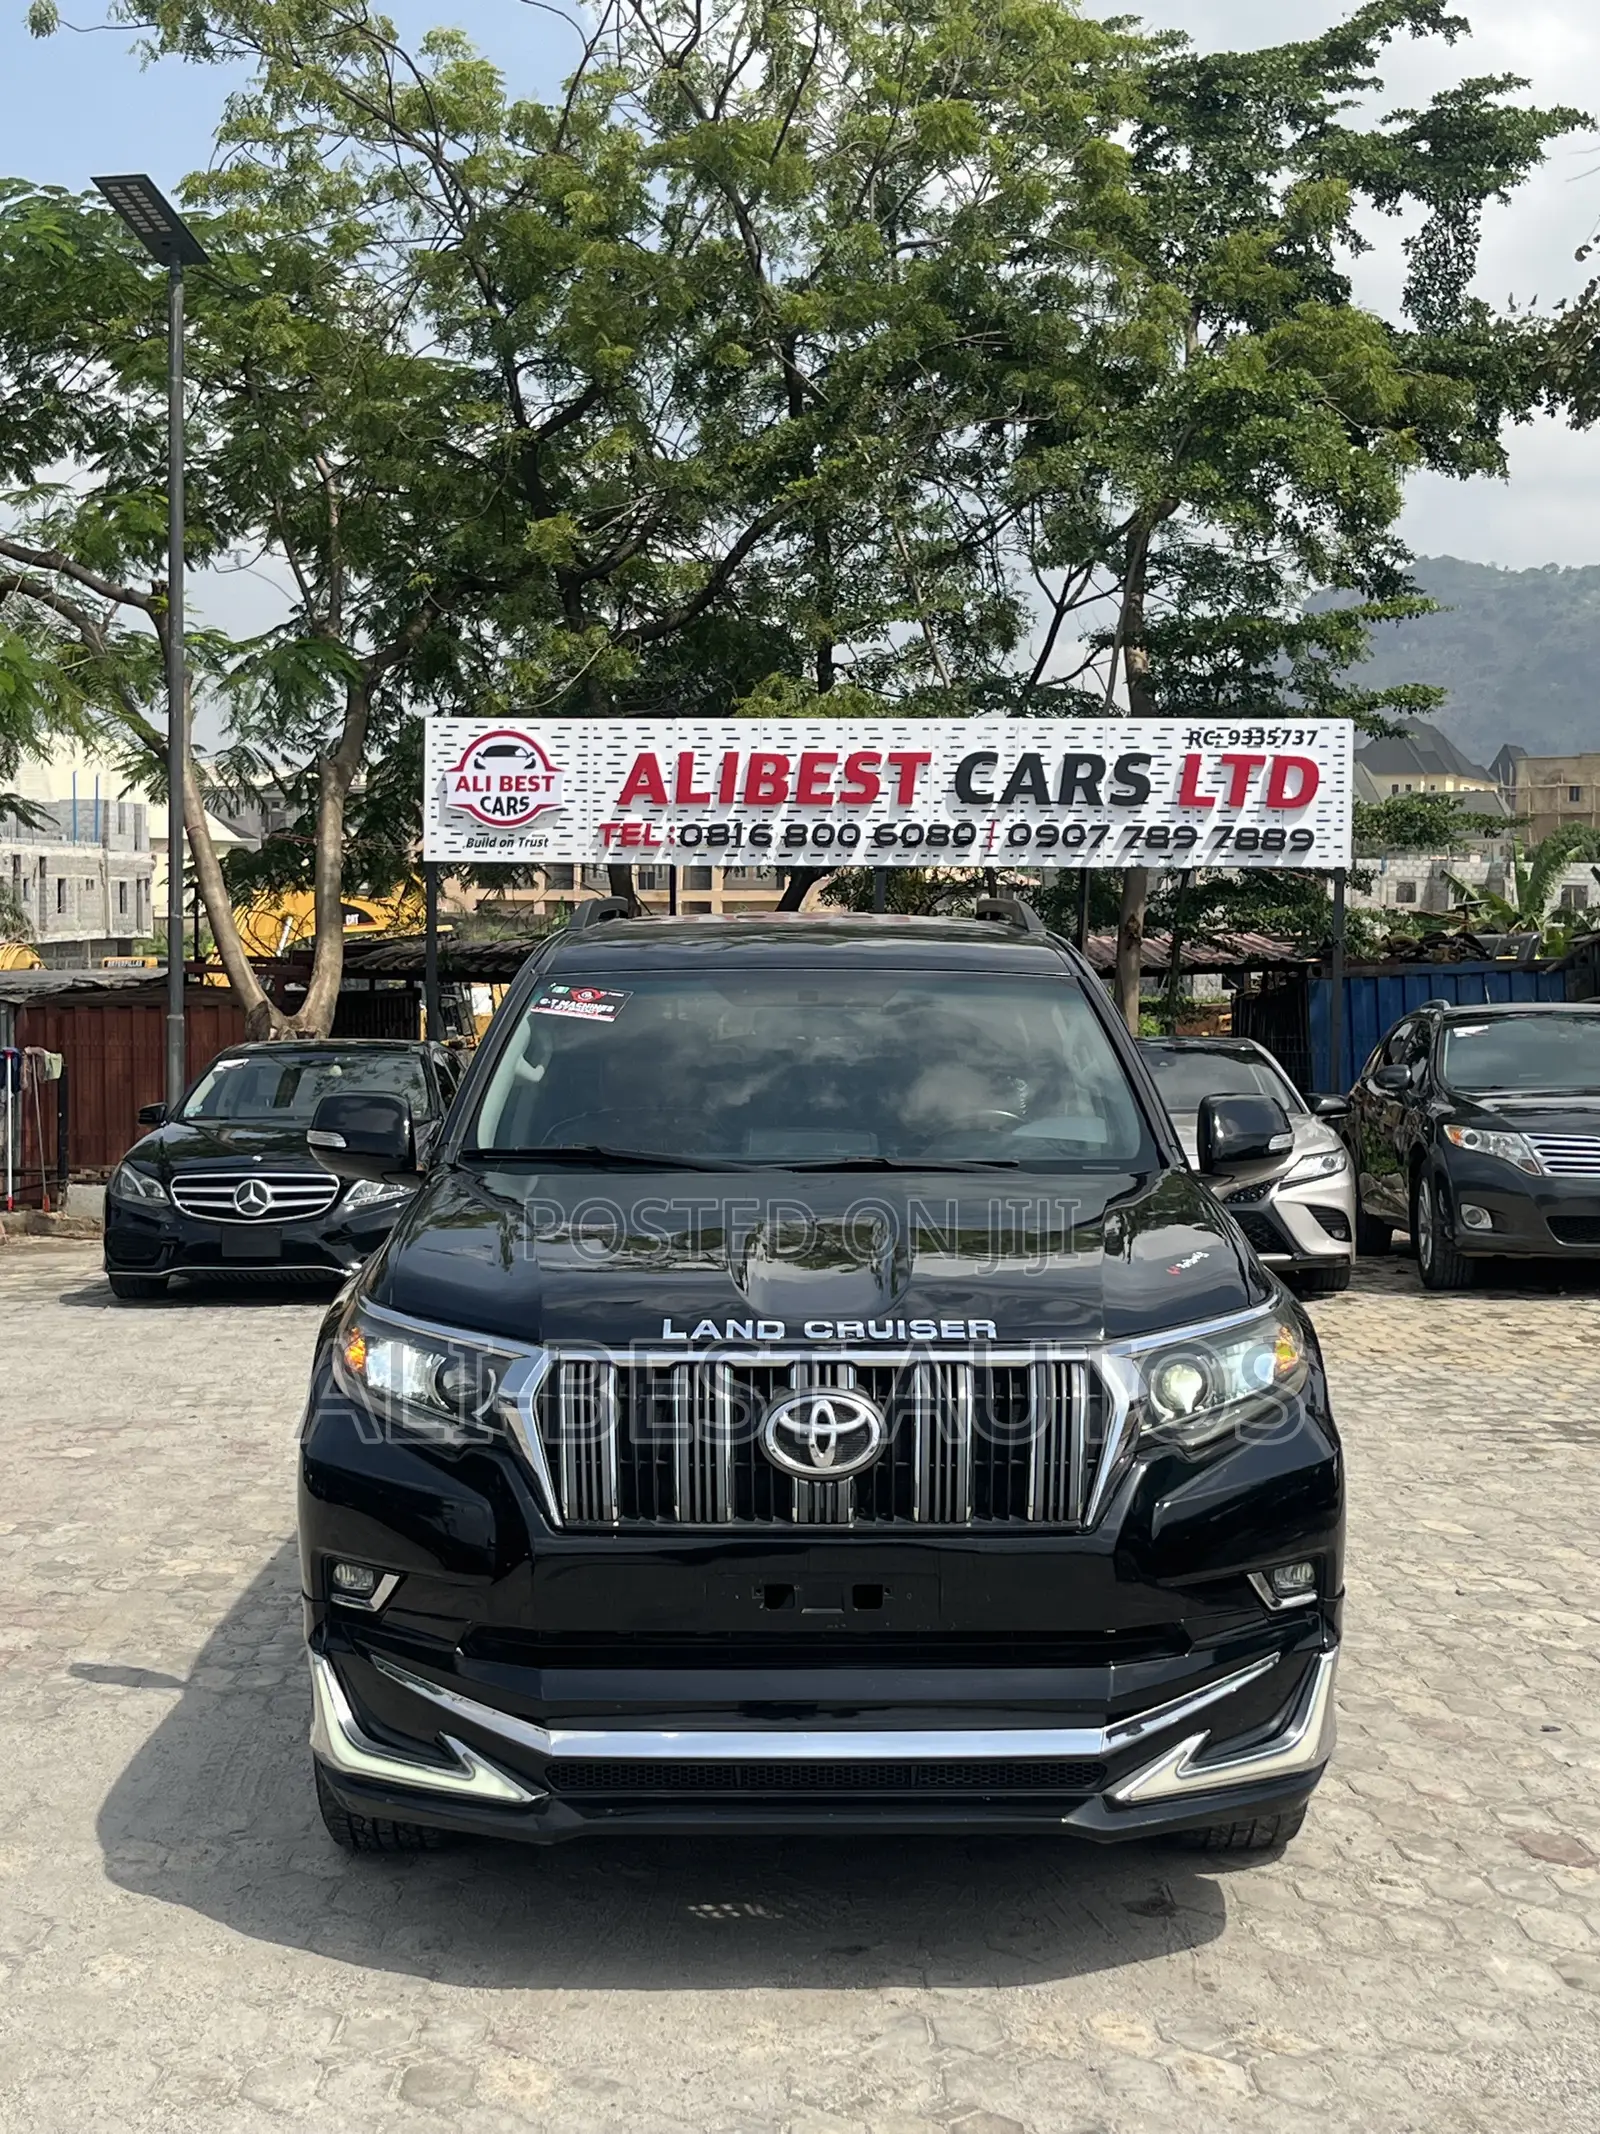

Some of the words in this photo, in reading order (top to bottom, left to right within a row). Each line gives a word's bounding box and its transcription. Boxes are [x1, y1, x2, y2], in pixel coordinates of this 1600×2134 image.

[1228, 729, 1318, 746] 9335737
[454, 775, 491, 792] ALI
[499, 775, 555, 792] BEST
[616, 751, 932, 805] ALIBEST
[955, 751, 1152, 807] CARS
[1178, 752, 1320, 809] LTD
[479, 795, 530, 816] CARS
[465, 837, 498, 849] Build
[500, 840, 515, 848] on
[519, 837, 549, 848] Trust
[785, 824, 861, 848] 800
[873, 823, 976, 847] 6080
[1008, 823, 1110, 848] 0907
[1123, 825, 1198, 849] 789
[1211, 826, 1314, 852] 7889
[662, 1318, 785, 1341] LAND
[804, 1318, 997, 1341] CRUISER
